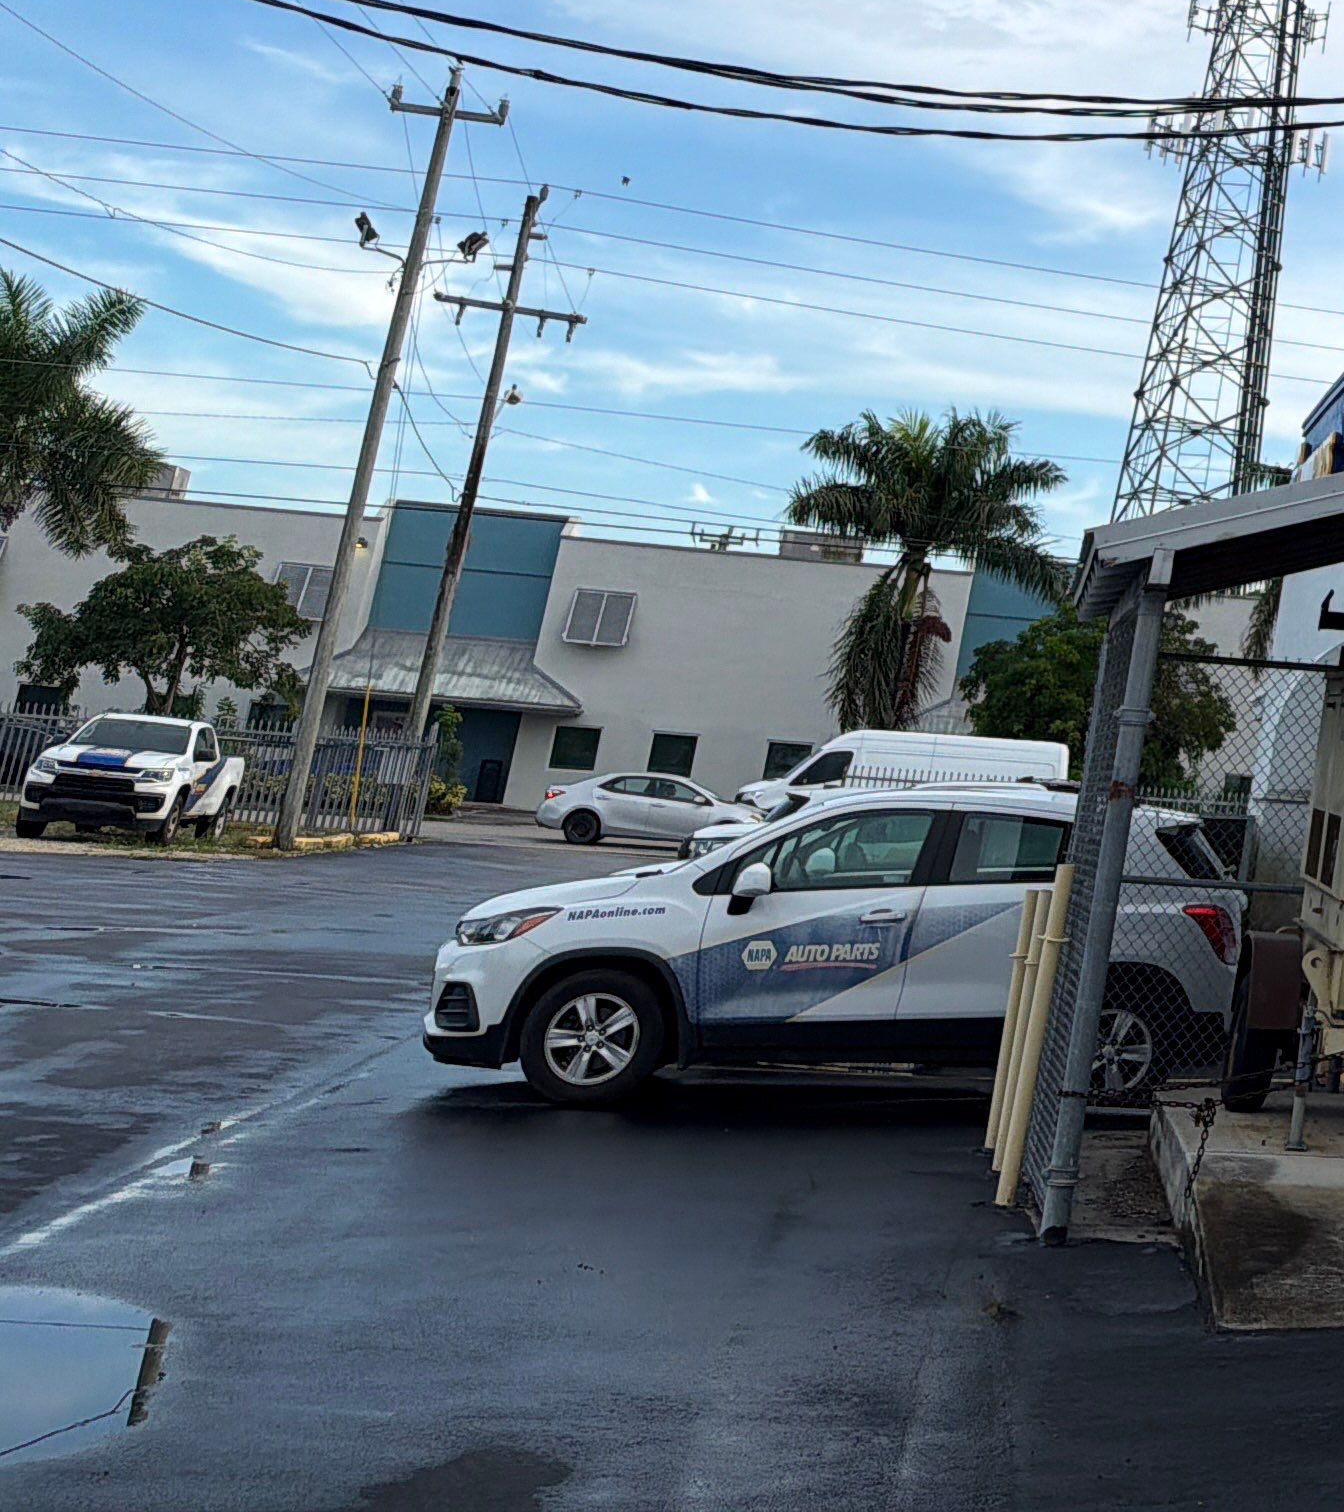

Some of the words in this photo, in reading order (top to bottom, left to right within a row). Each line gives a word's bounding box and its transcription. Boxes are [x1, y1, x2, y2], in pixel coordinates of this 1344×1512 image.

[567, 907, 666, 921] NAPAonline.com
[747, 948, 772, 963] NAPA
[784, 944, 829, 963] AUTO
[830, 942, 880, 962] PARTS
